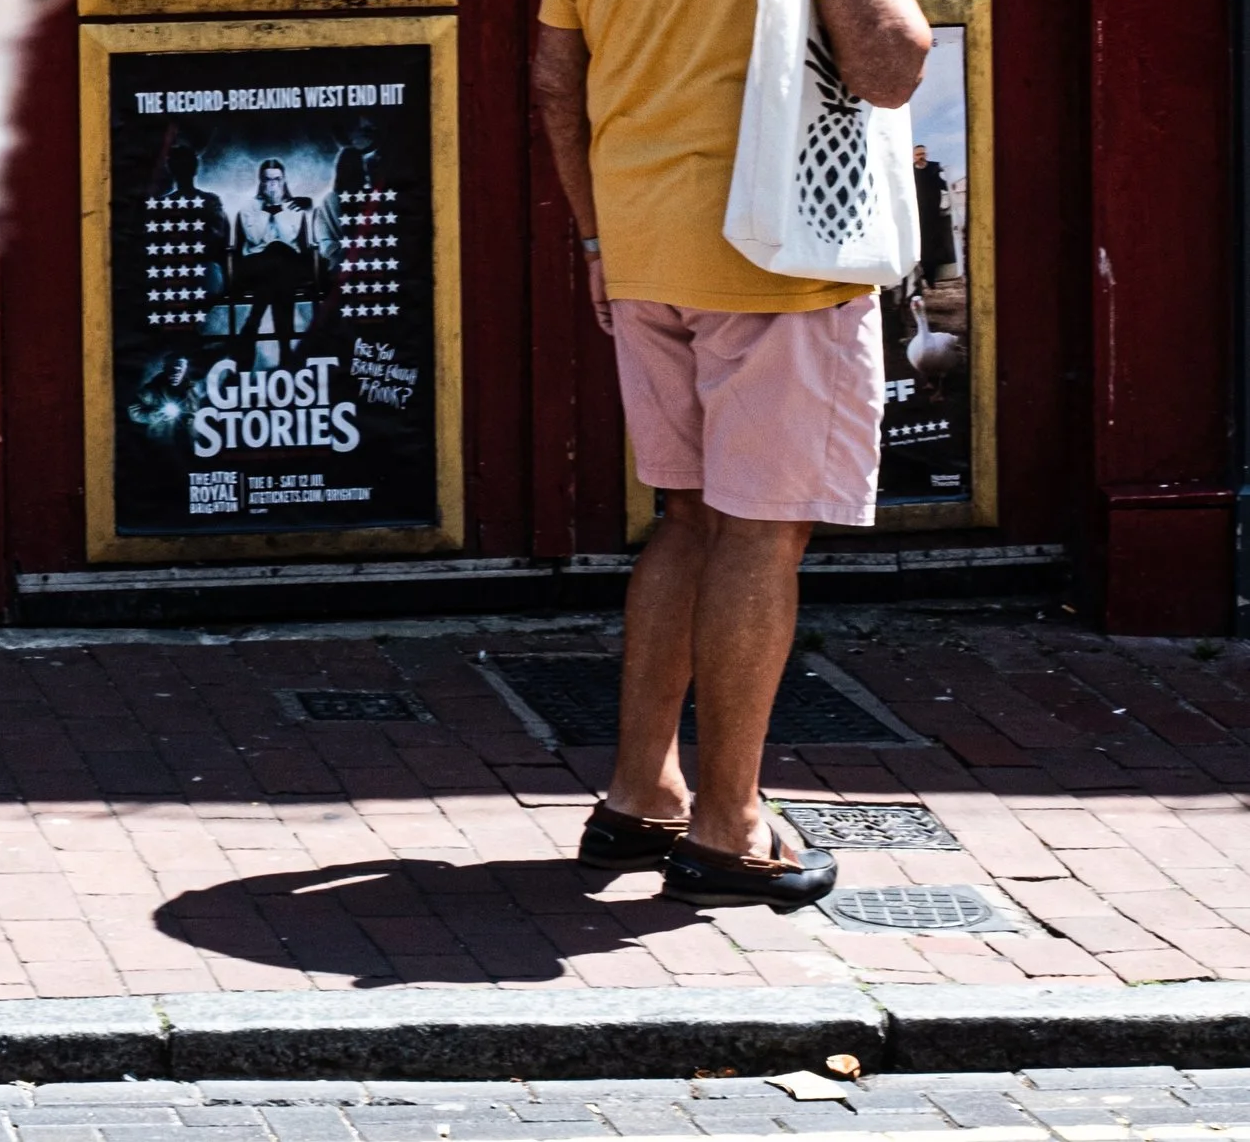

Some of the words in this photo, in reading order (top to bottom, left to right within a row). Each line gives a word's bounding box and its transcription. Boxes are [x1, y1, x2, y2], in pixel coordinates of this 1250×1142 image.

[135, 92, 164, 114] THE
[166, 87, 302, 113] RECORD-BREAKING
[303, 85, 345, 108] WEST
[347, 84, 377, 107] END
[379, 83, 405, 105] HIT
[206, 356, 340, 409] GHOST
[885, 378, 915, 404] FF
[193, 401, 361, 458] STORIES
[188, 471, 238, 486] THEATRE
[279, 475, 297, 488] SAT
[298, 474, 308, 487] 12
[189, 484, 238, 503] ROYAL
